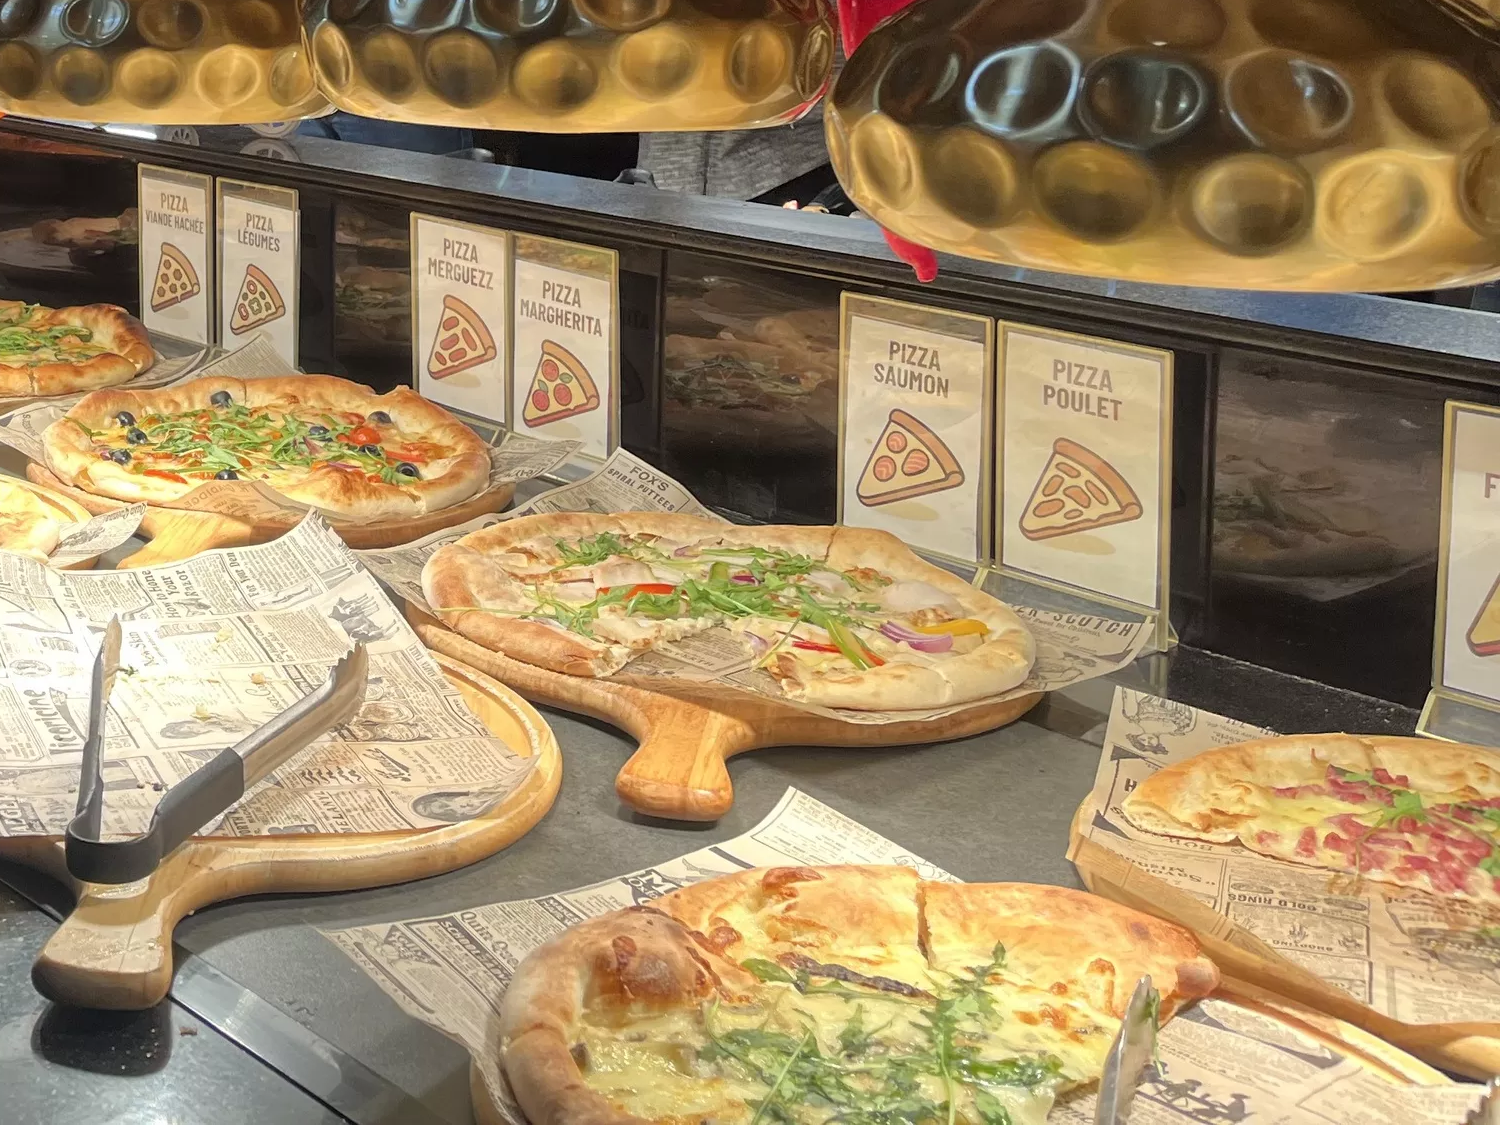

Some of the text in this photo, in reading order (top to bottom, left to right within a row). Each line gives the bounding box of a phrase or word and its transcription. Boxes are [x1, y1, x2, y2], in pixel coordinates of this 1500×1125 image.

[160, 192, 189, 214] PIZZA
[145, 209, 204, 235] VIANDE HACHÉE
[245, 212, 274, 234] PIZZA
[237, 228, 280, 253] LÉGUMES
[443, 237, 478, 264] PIZZA
[427, 257, 494, 291] MERGUEZZ
[542, 280, 581, 308] PIZZA
[519, 298, 602, 337] MARGHERITA
[888, 340, 941, 372] PIZZA
[874, 362, 949, 399] SAUMON
[1052, 358, 1113, 393] PIZZA
[1043, 384, 1123, 421] POULET
[607, 468, 636, 488] SPIRAL
[639, 484, 676, 512] PUTTEES
[629, 465, 670, 492] FOX'S
[160, 575, 180, 596] Your
[174, 569, 199, 597] Razor
[245, 584, 260, 598] For
[162, 602, 181, 618] How
[1228, 893, 1318, 912] GOLD RINGS
